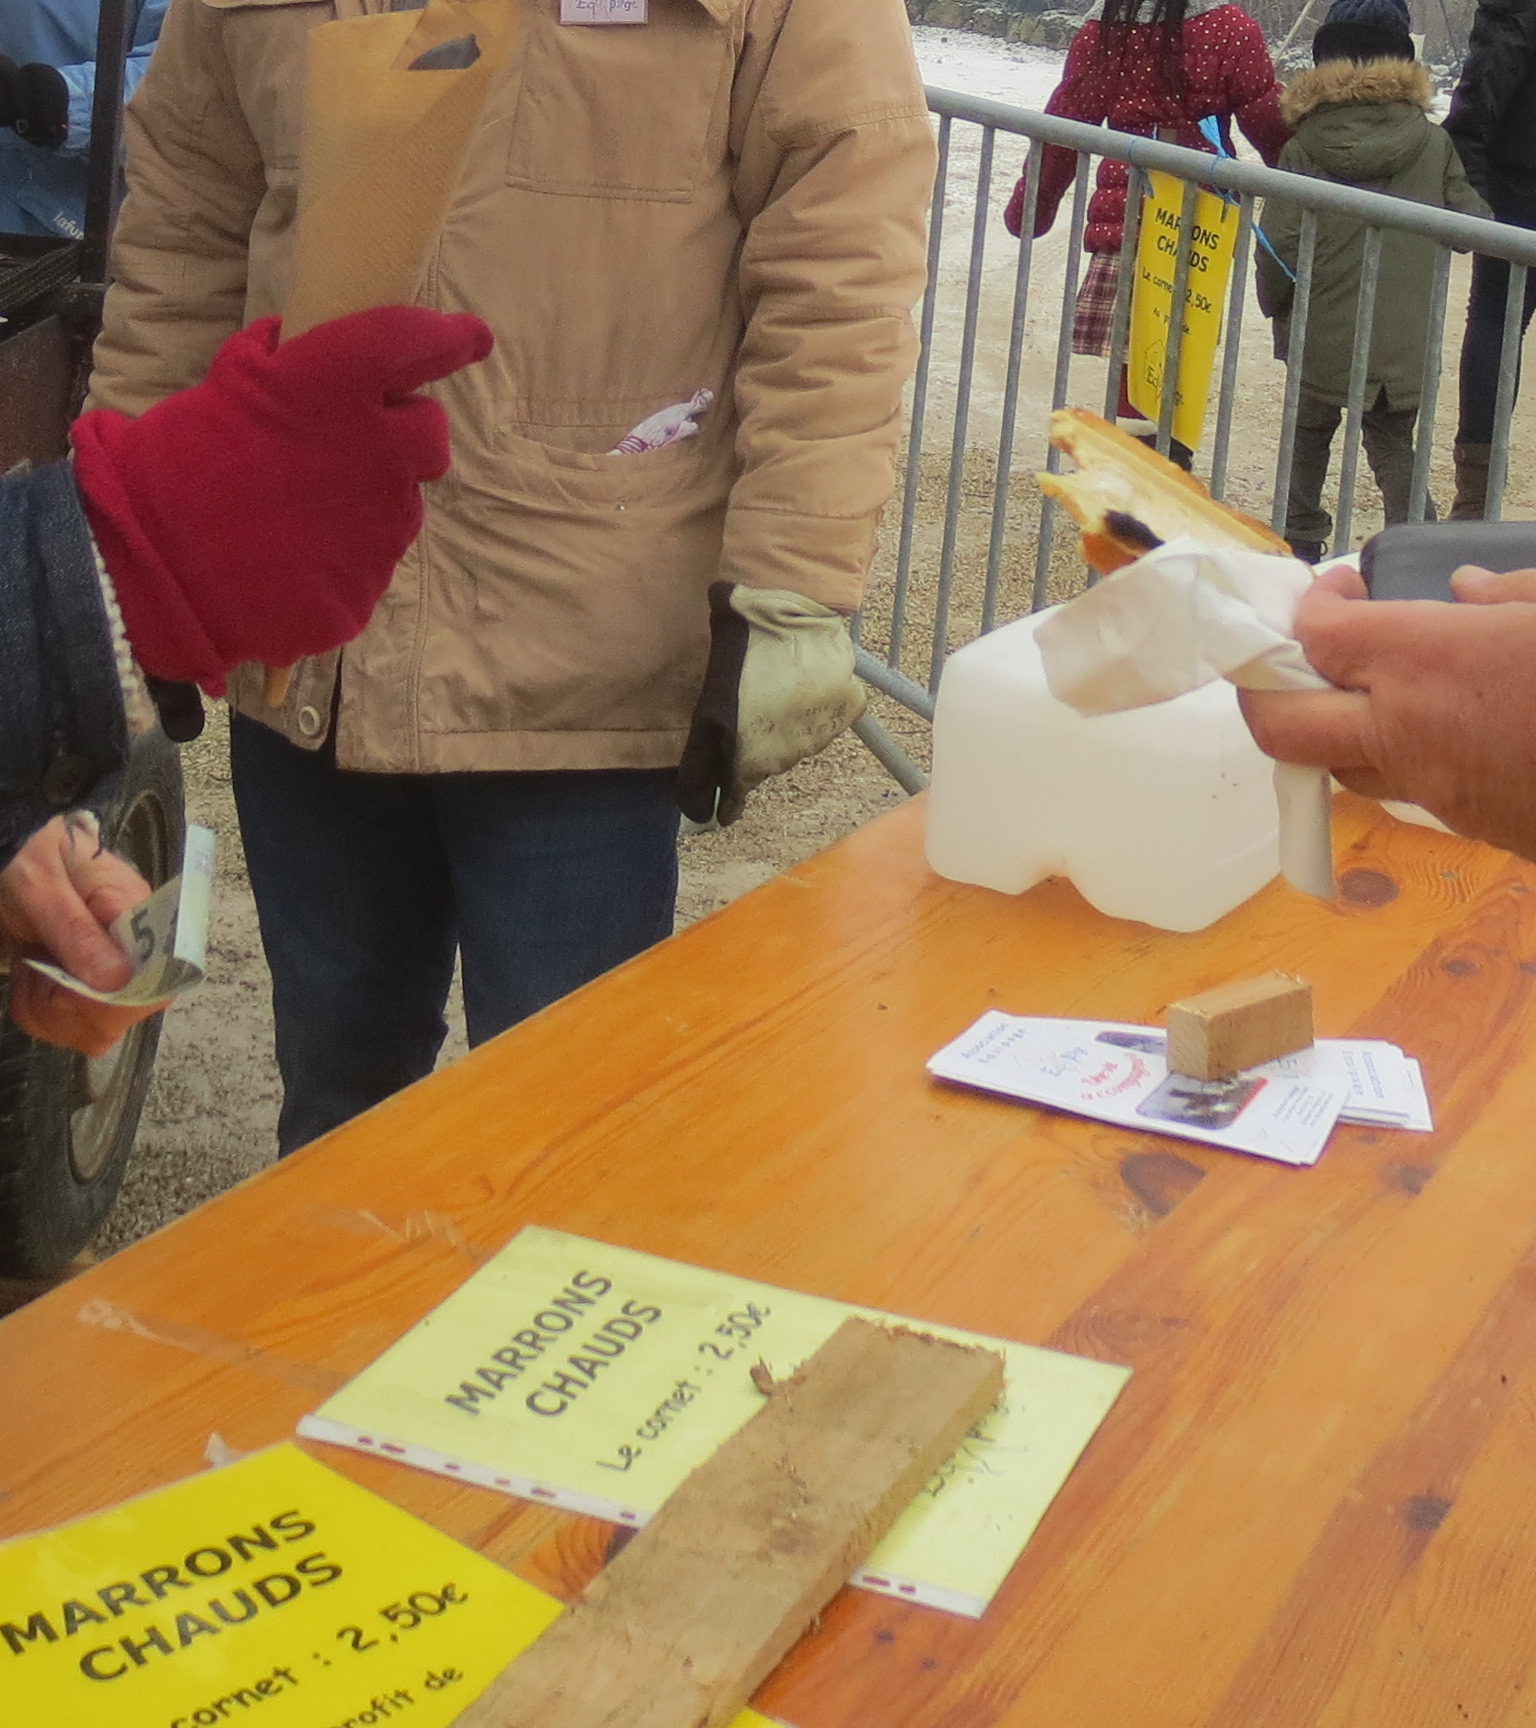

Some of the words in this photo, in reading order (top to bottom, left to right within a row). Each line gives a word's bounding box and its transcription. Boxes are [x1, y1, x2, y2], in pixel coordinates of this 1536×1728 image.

[1154, 207, 1220, 251] MAONS
[1156, 234, 1210, 273] CHDS
[1153, 276, 1173, 294] corne
[444, 1269, 613, 1416] MARRONS
[525, 1299, 663, 1417] CHAUDS
[596, 1444, 643, 1472] Le
[635, 1379, 703, 1442] cornet
[79, 1551, 344, 1683] CHAUDS
[170, 1666, 298, 1728] cornet
[336, 1581, 470, 1653] 2,50€
[331, 1689, 416, 1728] rofit
[425, 1667, 464, 1691] de
